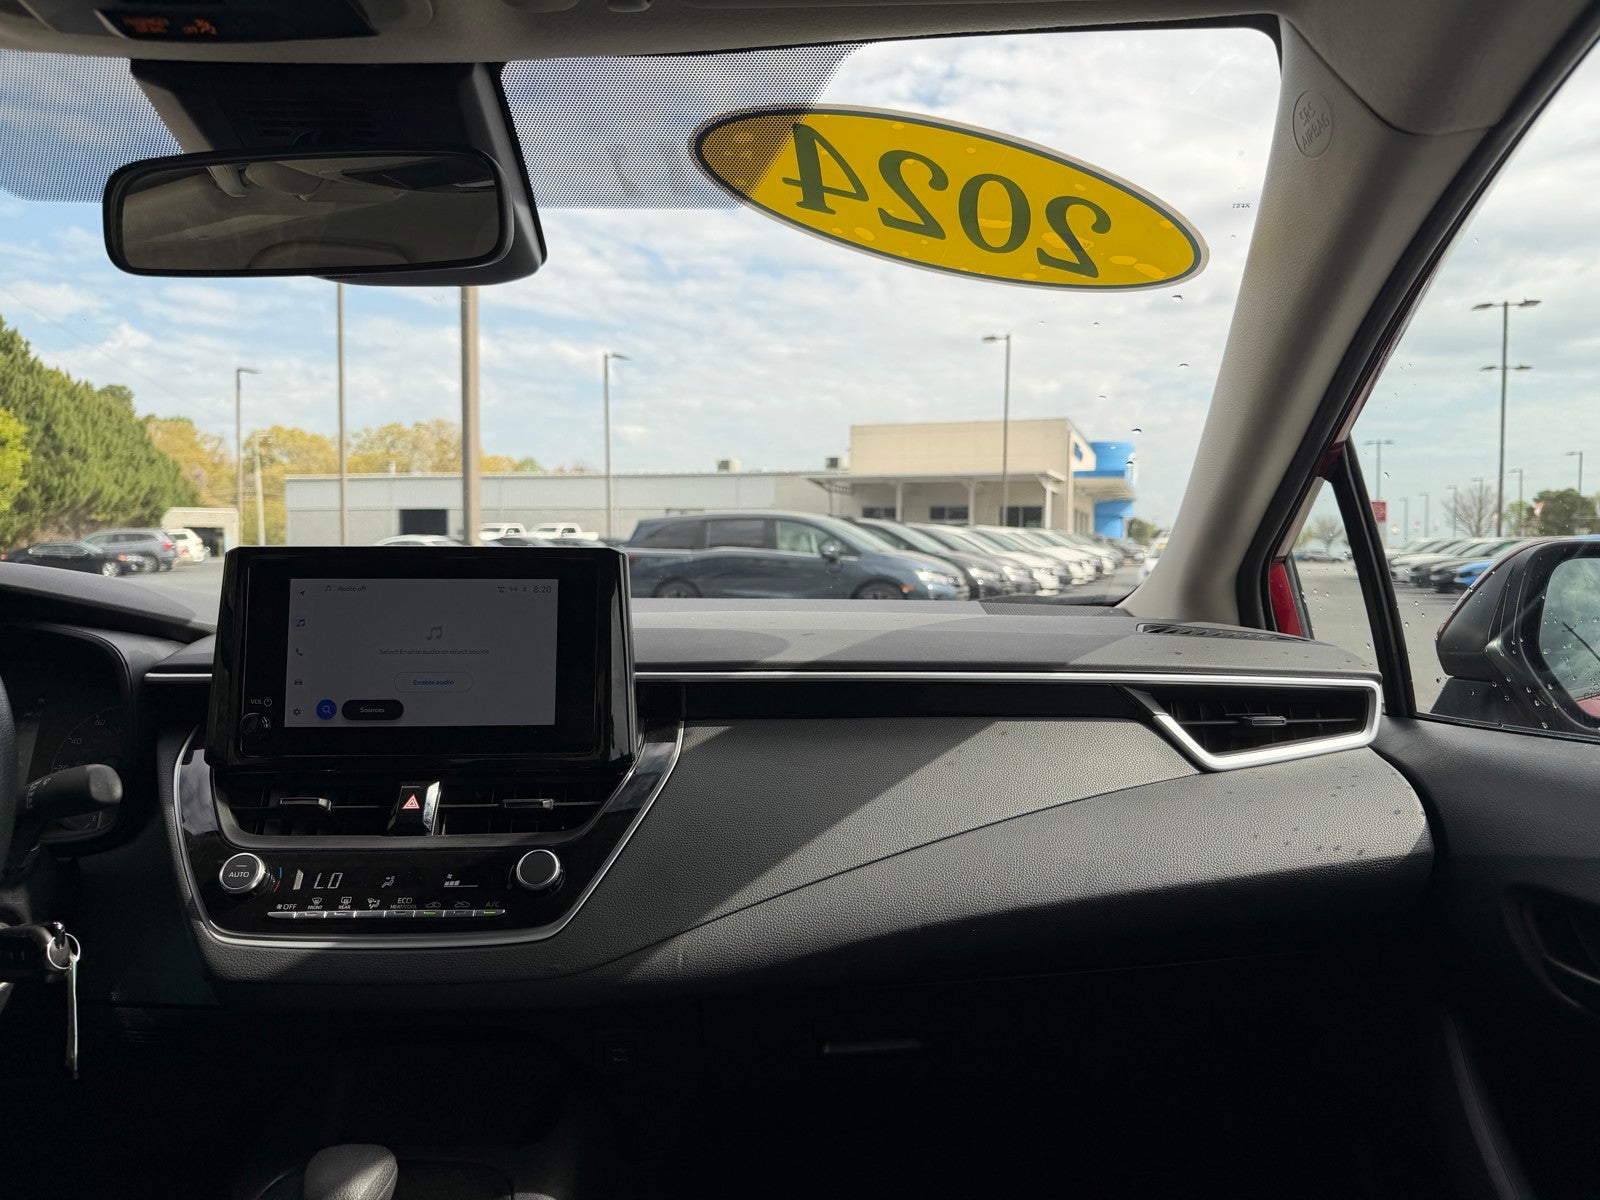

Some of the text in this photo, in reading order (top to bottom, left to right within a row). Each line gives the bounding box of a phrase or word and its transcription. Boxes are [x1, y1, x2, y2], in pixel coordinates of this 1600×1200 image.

[1299, 101, 1316, 126] SRS
[1301, 112, 1331, 151] AIRBAG
[337, 584, 357, 592] Audio
[533, 585, 552, 593] 8:20
[379, 648, 399, 656] Select
[399, 648, 421, 656] Enable
[422, 648, 440, 656] audio
[449, 648, 469, 656] select
[359, 706, 385, 714] Sources
[228, 870, 250, 878] AUTO
[313, 871, 343, 889] LO
[485, 900, 501, 908] A/C
